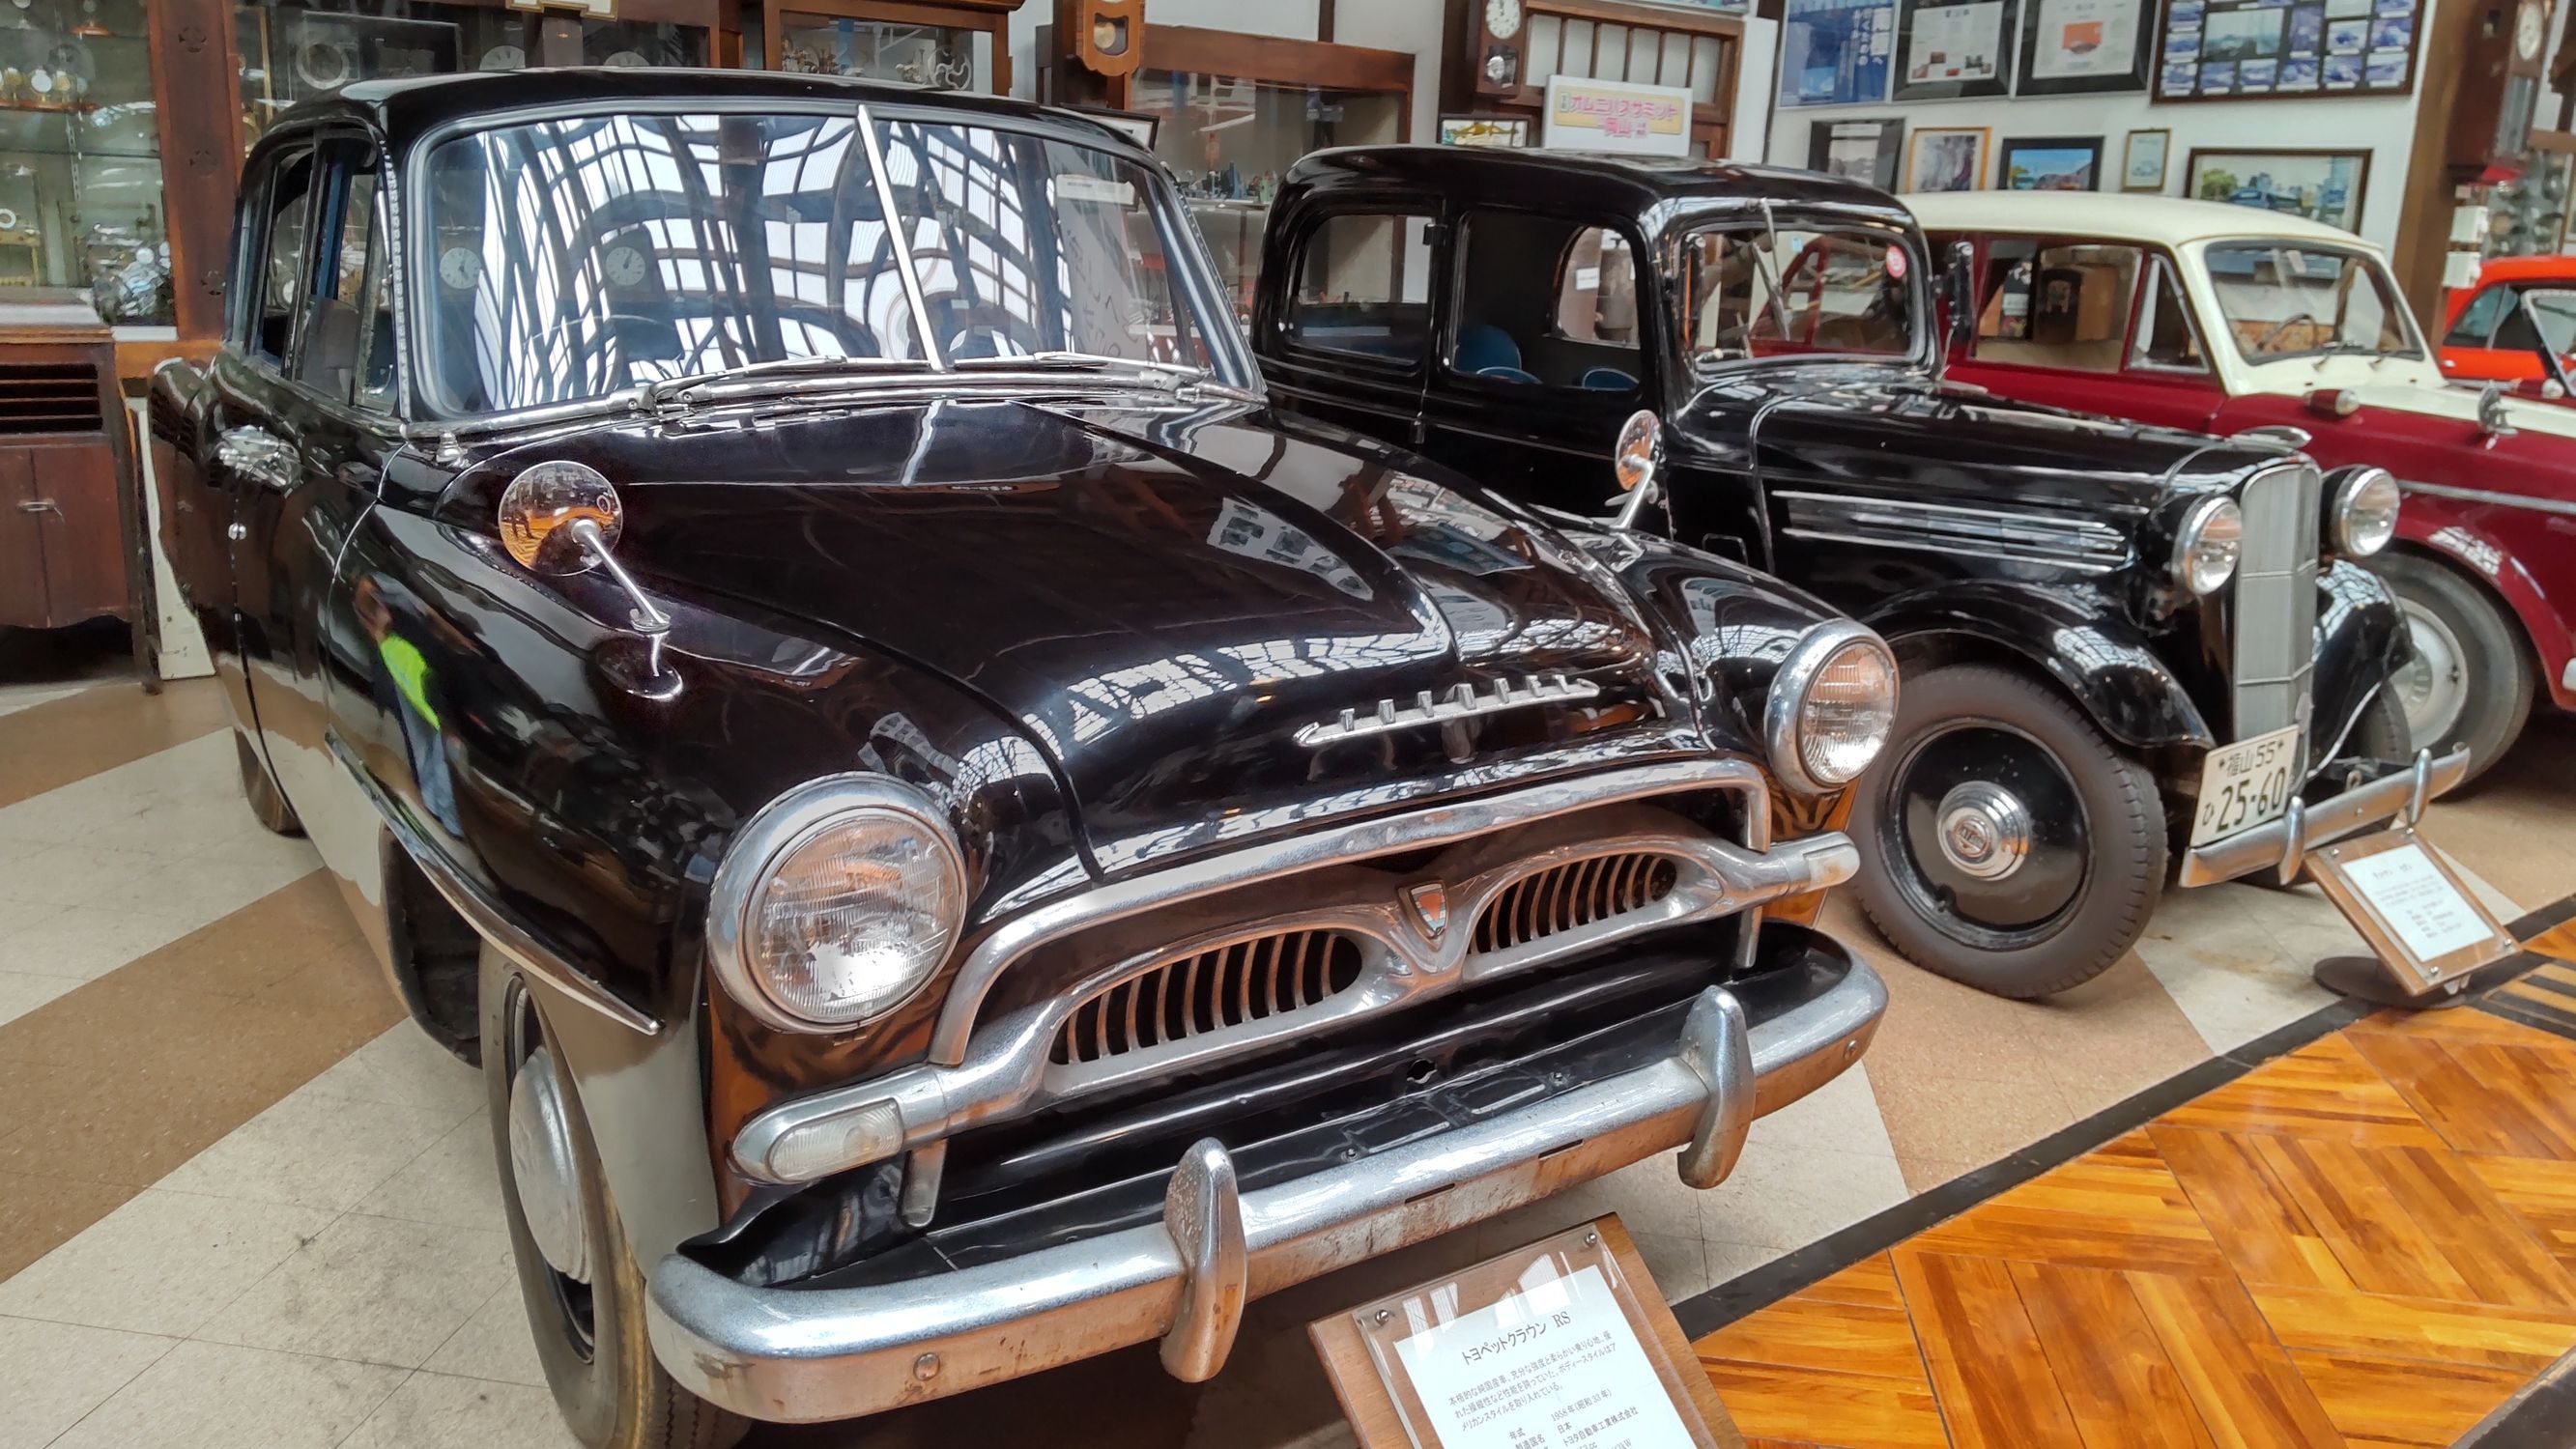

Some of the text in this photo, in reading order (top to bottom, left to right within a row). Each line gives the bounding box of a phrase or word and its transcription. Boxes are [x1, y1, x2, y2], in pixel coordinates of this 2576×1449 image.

[1461, 1311, 1571, 1365] トヨペットクラウン RS
[1509, 1427, 1526, 1439] 年式
[1557, 1422, 1572, 1434] 日本
[1563, 1406, 1639, 1446] トヨタ自動車工業株式会社
